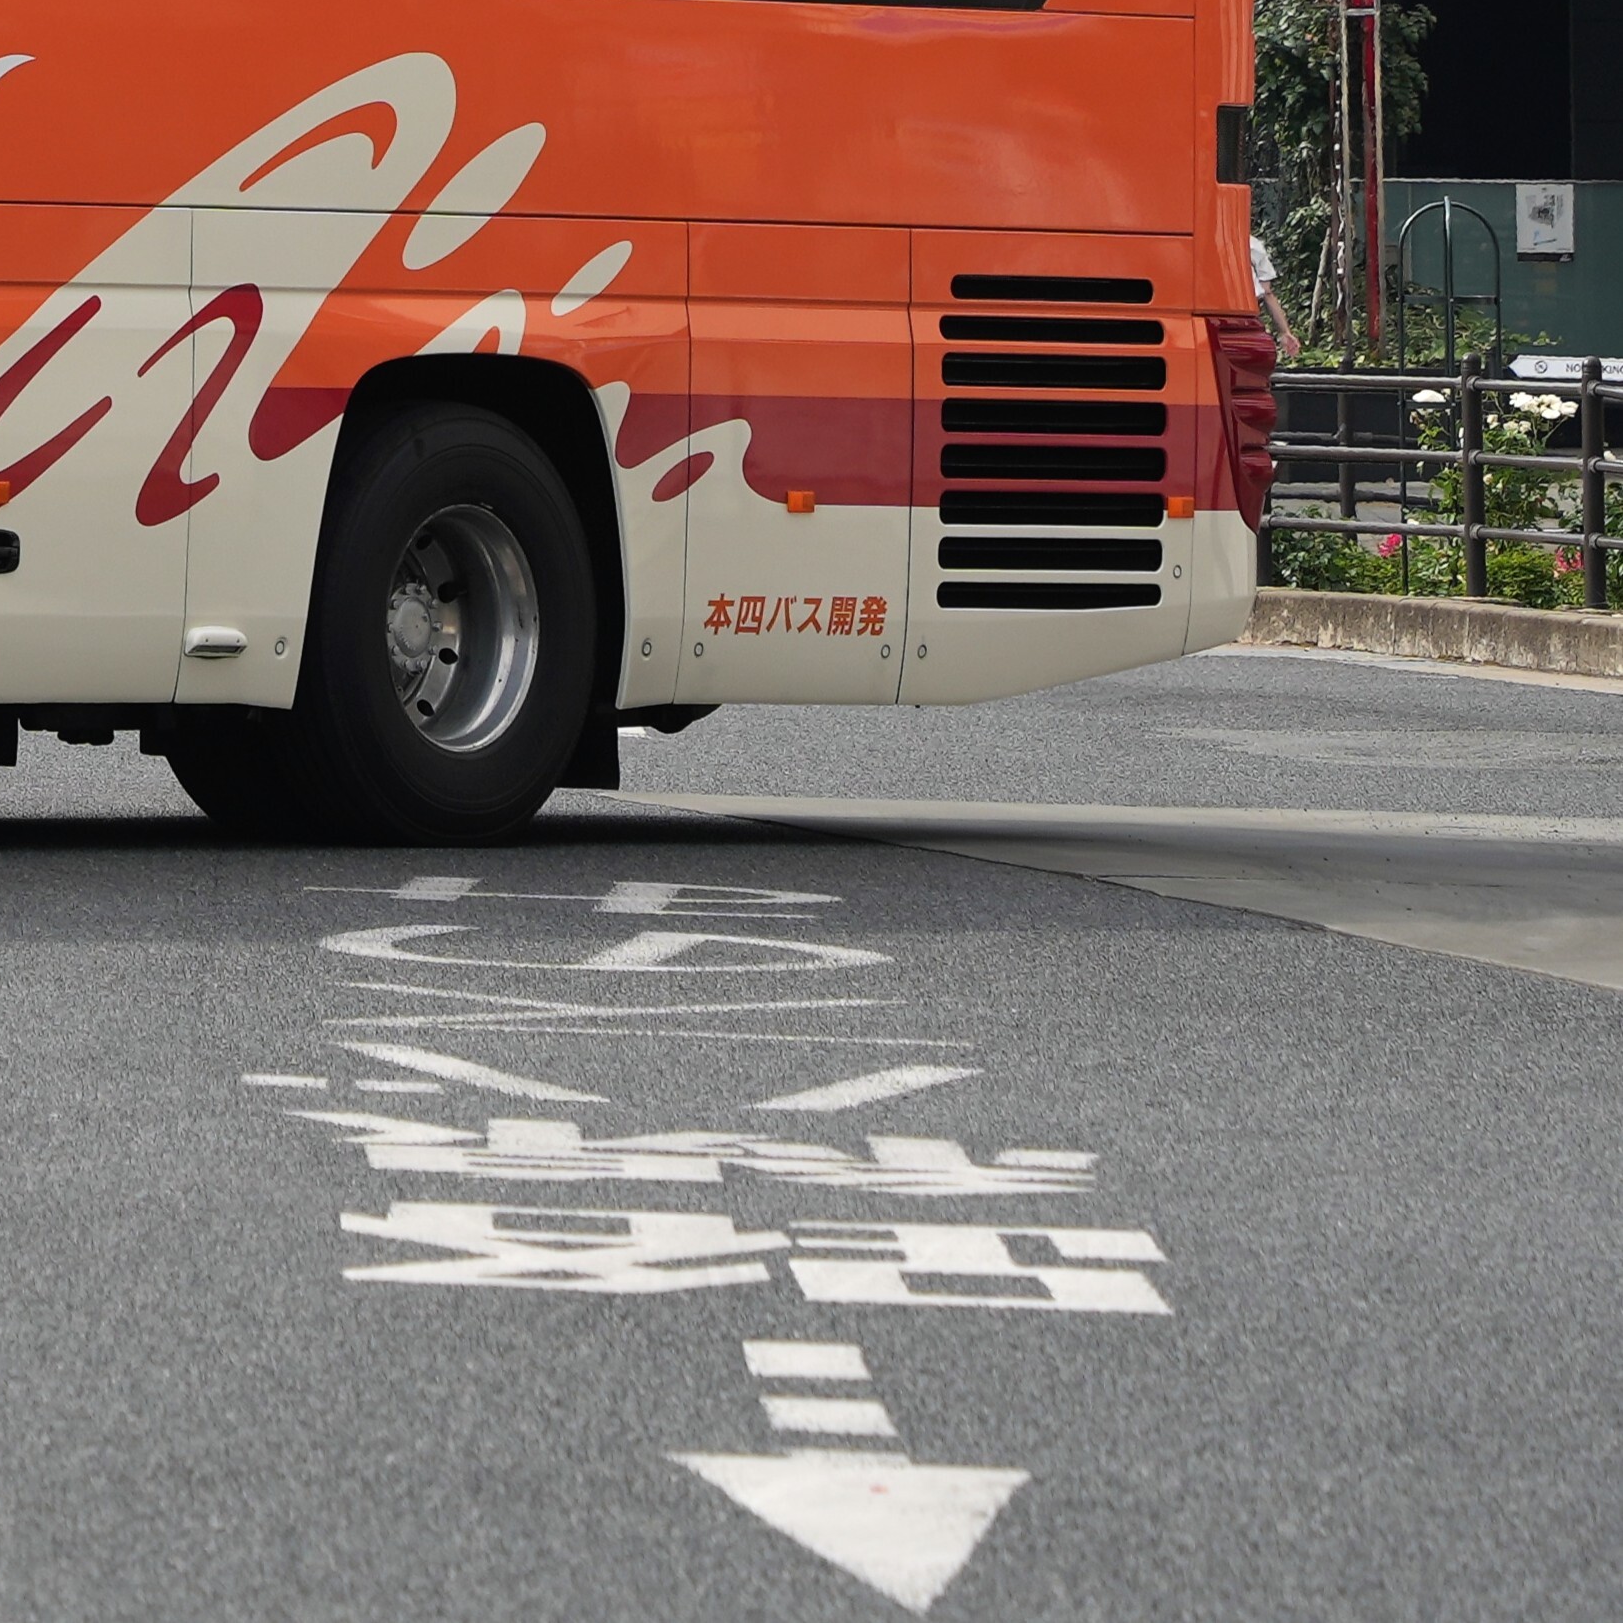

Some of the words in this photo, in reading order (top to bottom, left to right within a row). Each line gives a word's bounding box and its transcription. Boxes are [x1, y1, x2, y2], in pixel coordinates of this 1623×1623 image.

[704, 593, 888, 636] 本四バス開発
